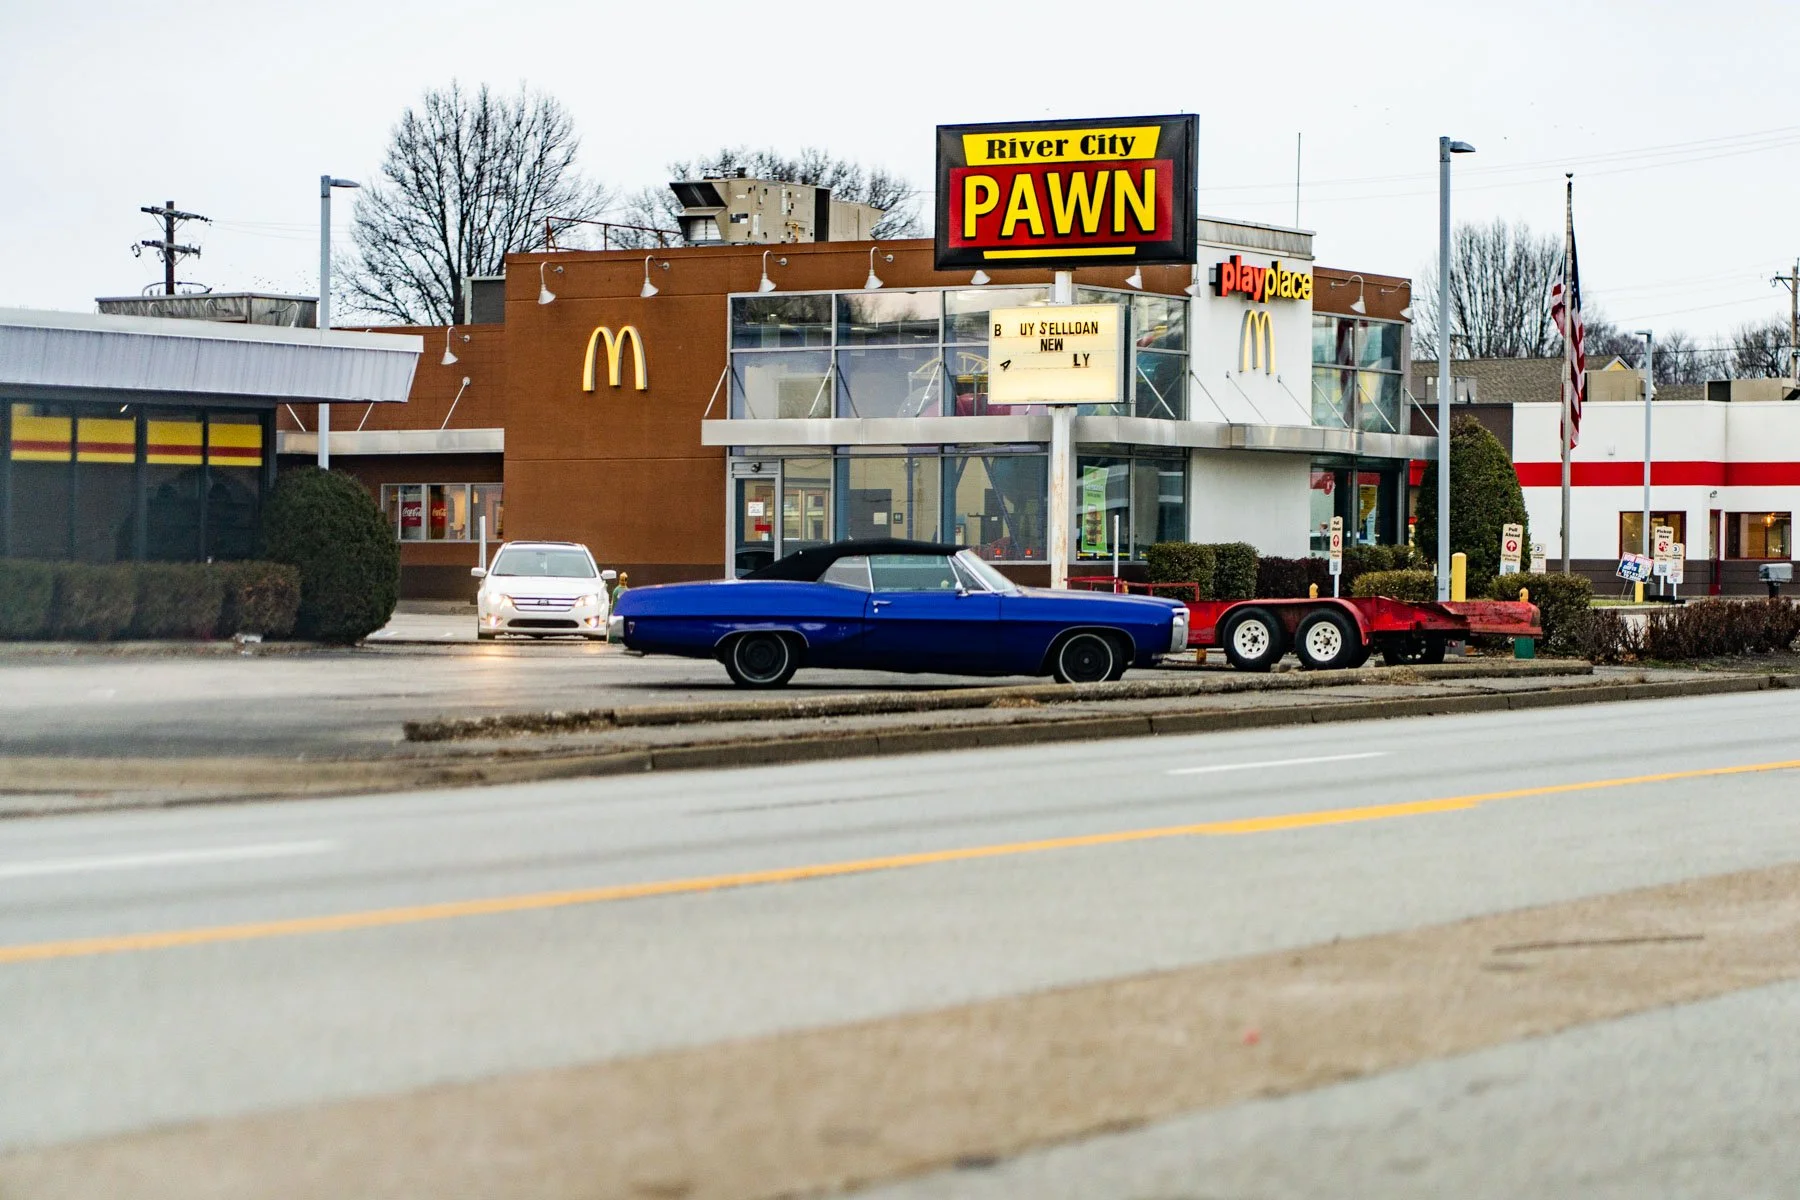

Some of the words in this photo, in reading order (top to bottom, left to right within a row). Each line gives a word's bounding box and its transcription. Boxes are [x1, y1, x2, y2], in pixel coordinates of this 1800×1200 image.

[986, 137, 1069, 160] River
[1080, 133, 1136, 157] City
[964, 168, 1156, 238] PAWN
[1220, 254, 1313, 305] playplace
[1040, 338, 1064, 352] NEW
